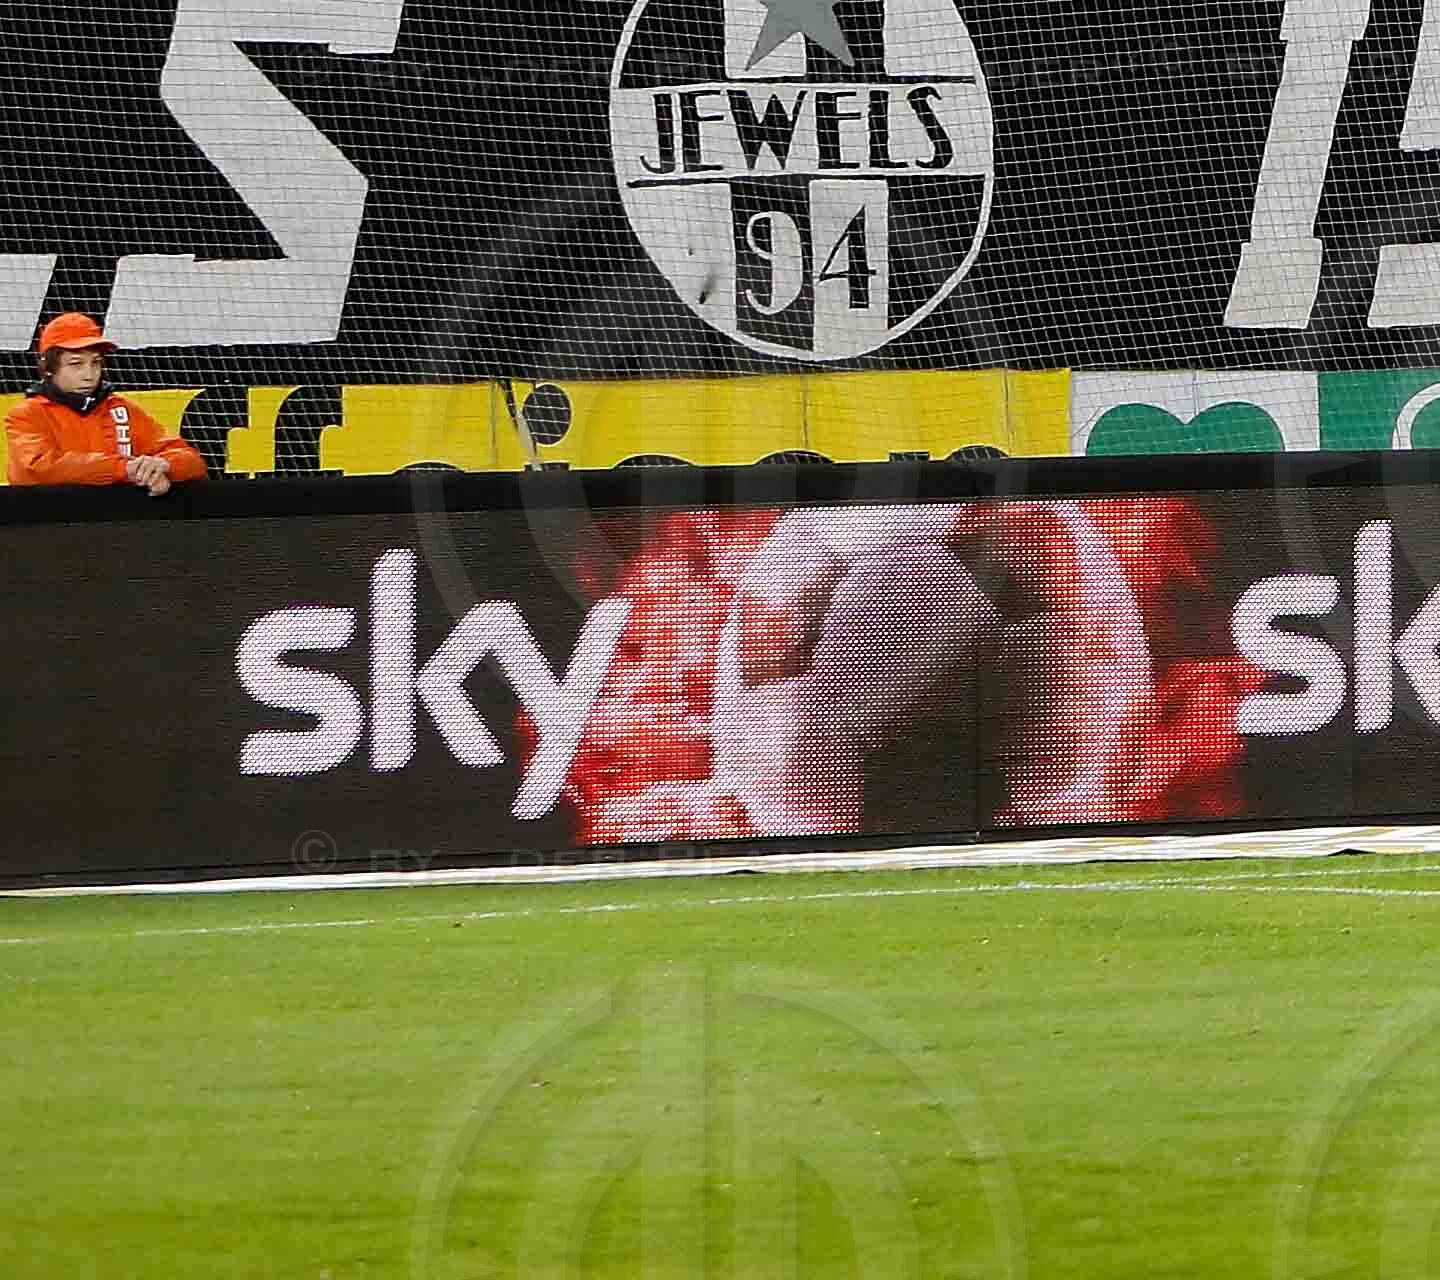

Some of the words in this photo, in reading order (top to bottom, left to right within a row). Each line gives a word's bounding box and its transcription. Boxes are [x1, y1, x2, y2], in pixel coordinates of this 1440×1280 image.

[638, 85, 955, 177] JEWELS
[744, 203, 884, 317] 94
[238, 547, 632, 820] sky
